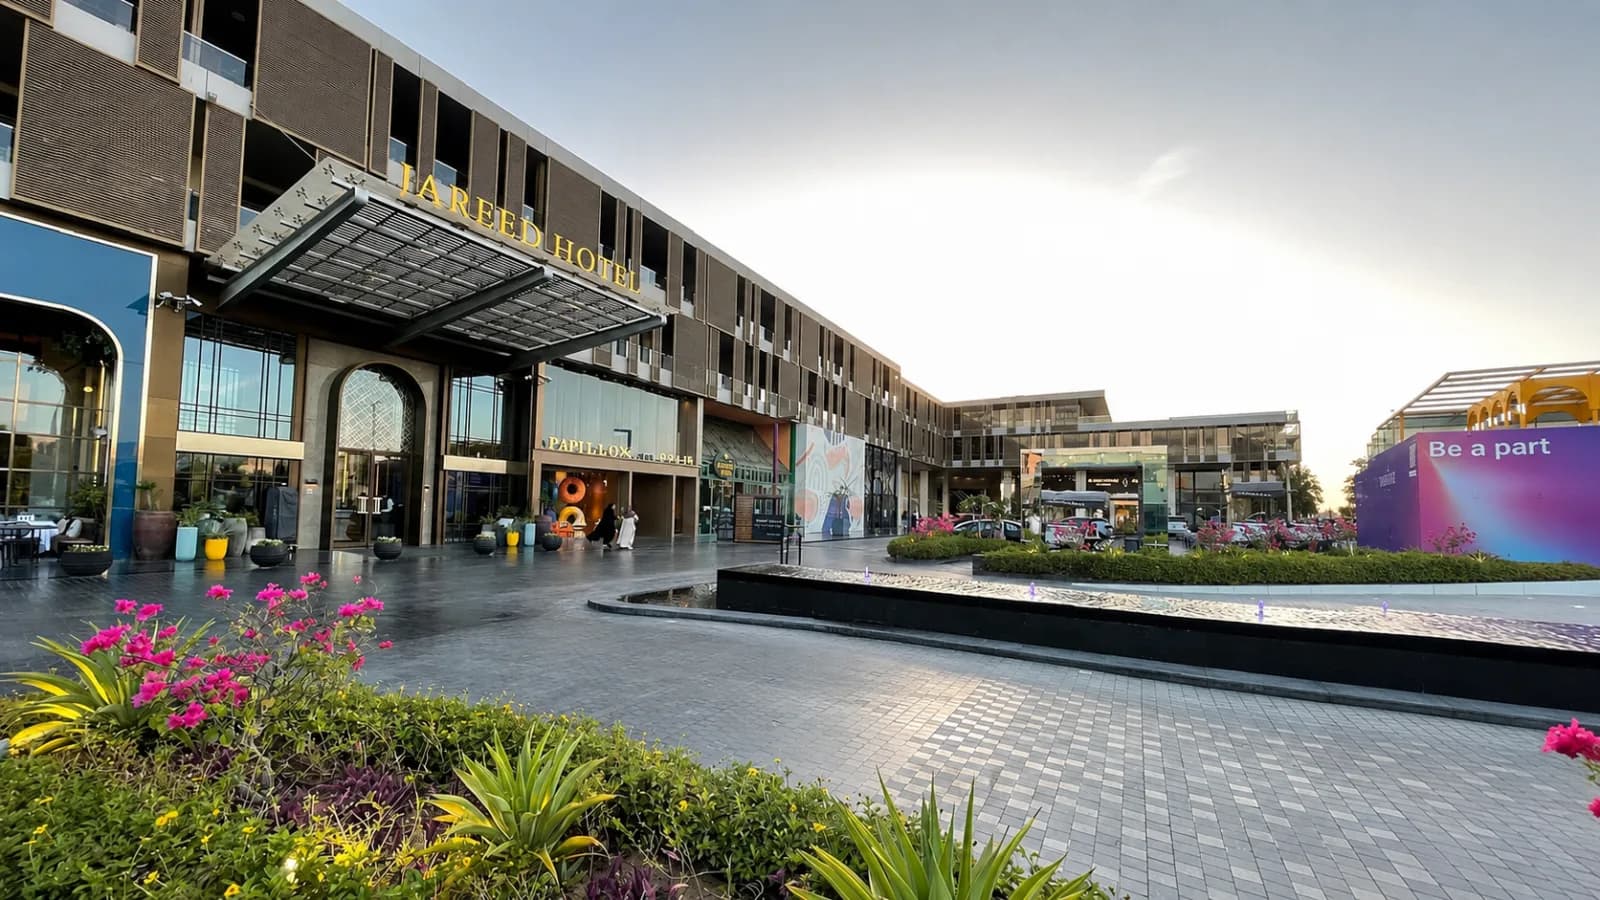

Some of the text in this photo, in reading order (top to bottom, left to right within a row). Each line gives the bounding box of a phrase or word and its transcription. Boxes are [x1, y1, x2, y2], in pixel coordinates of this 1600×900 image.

[399, 161, 641, 294] JAREED HOTEL
[1429, 438, 1551, 460] Be a part
